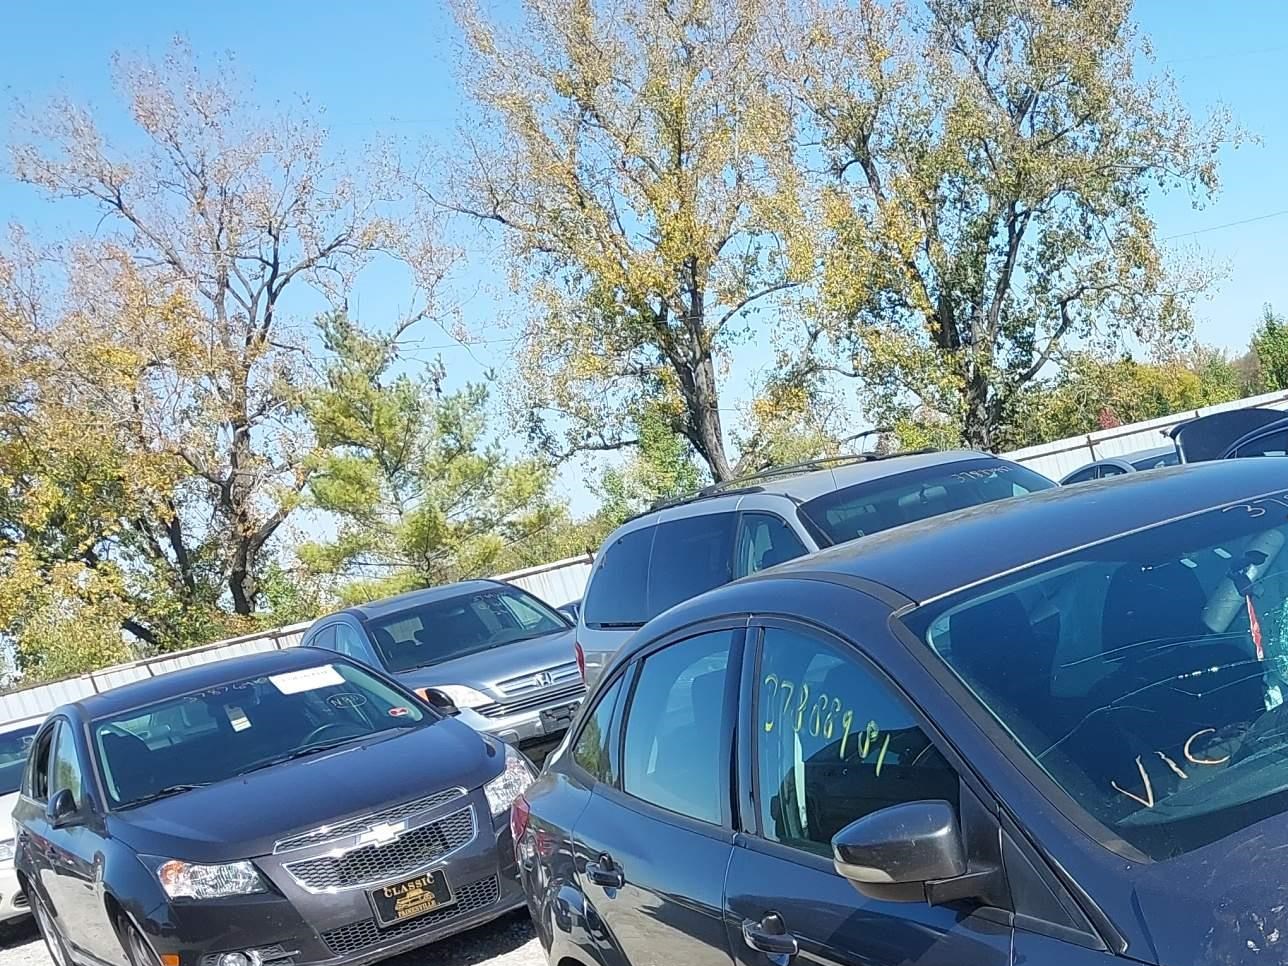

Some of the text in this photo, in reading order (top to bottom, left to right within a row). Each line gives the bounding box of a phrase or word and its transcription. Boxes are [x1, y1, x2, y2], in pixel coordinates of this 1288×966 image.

[1111, 727, 1231, 810] VIC
[383, 872, 435, 898] CLASSIC
[397, 898, 437, 918] PAINESVILLE
